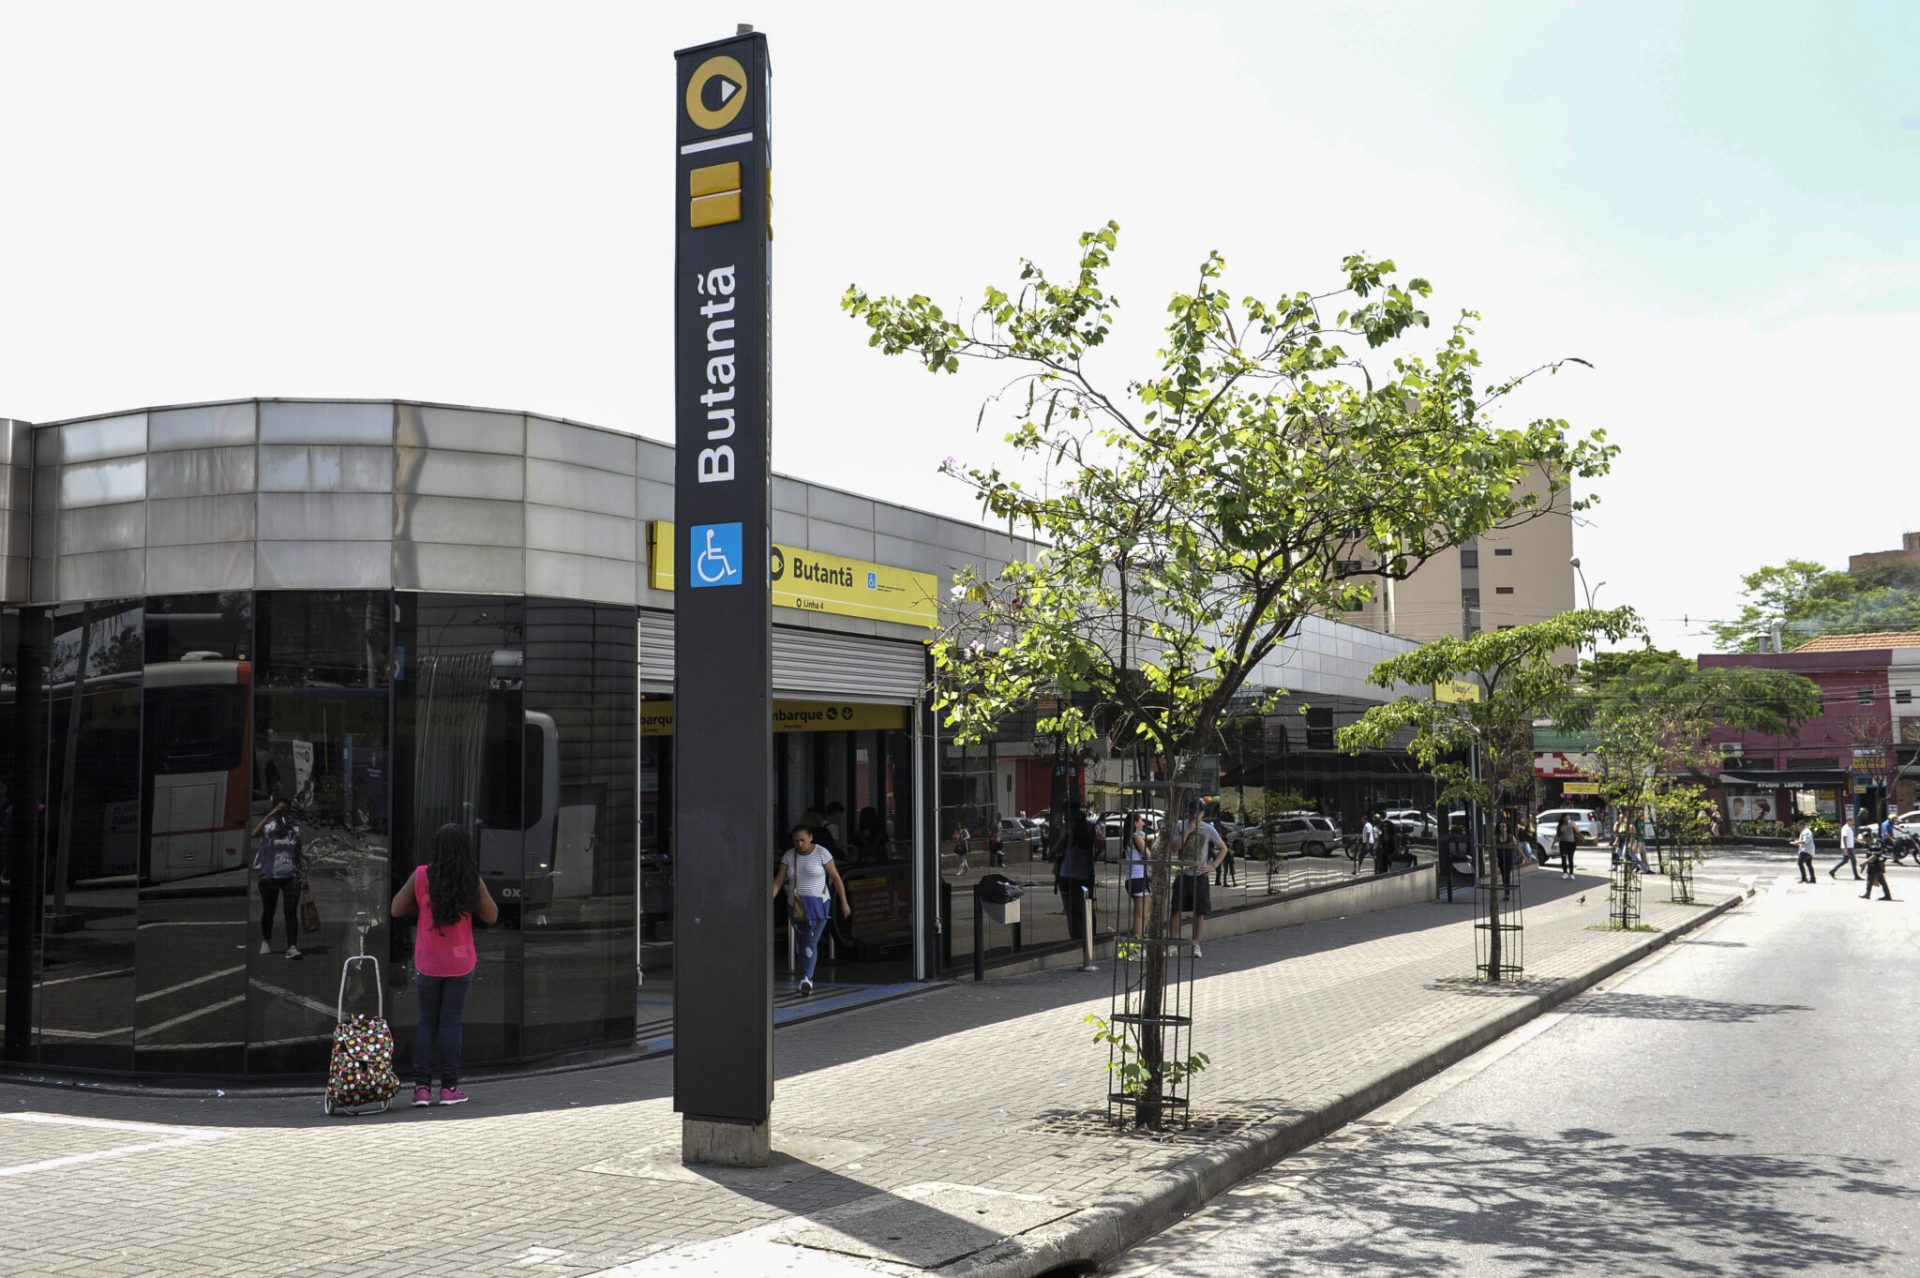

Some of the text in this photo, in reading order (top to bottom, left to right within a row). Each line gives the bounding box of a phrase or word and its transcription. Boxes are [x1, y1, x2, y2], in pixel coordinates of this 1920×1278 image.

[697, 264, 736, 483] Butantã
[793, 557, 853, 588] Butantã
[803, 600, 819, 611] Linha
